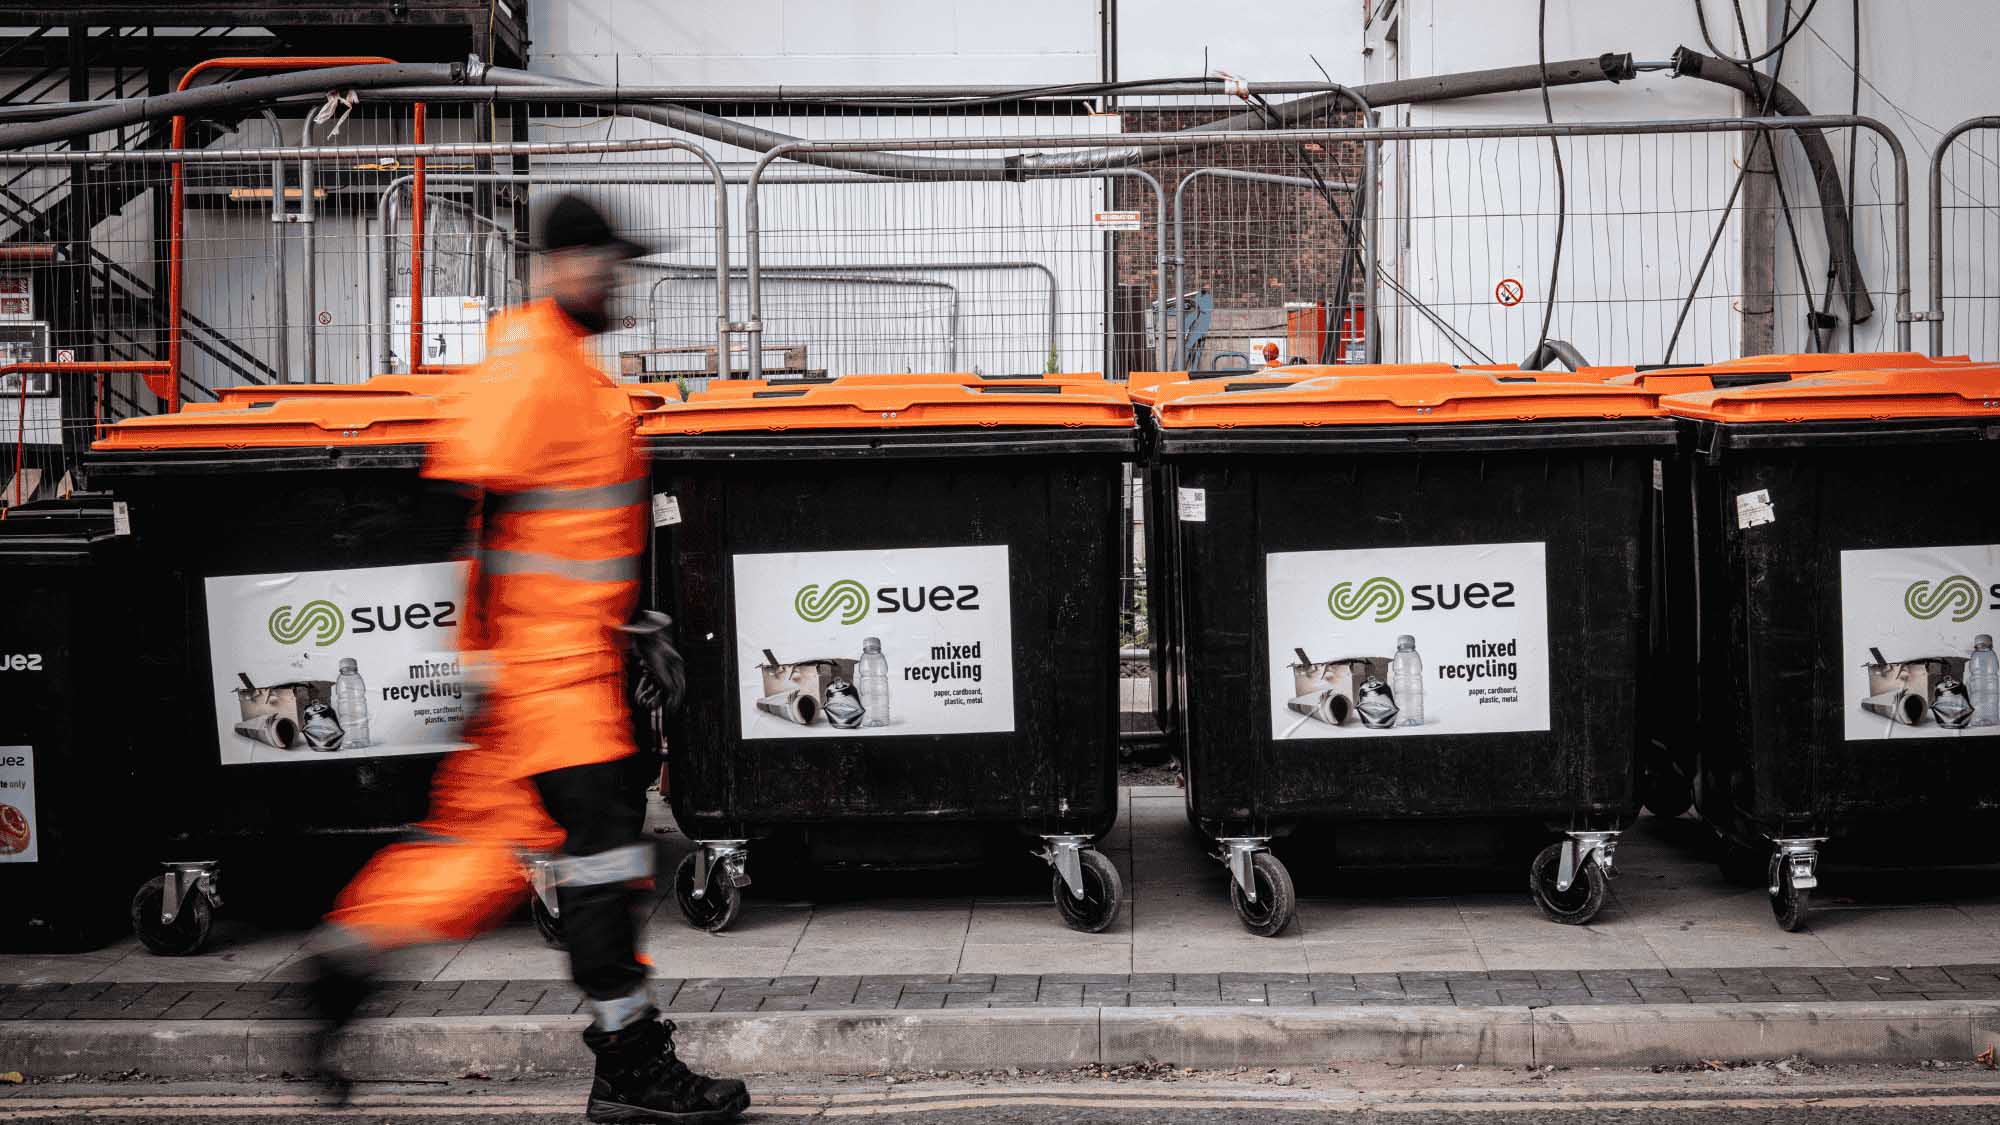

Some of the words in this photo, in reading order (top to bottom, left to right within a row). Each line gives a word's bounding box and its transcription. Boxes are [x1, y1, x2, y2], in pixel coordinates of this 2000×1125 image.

[877, 585, 980, 613] suez
[1411, 581, 1515, 610] suez
[351, 601, 457, 634] suez
[931, 641, 981, 660] mixed
[1466, 638, 1517, 658] mixed
[0, 653, 43, 671] uez
[409, 658, 461, 679] mixed
[1439, 660, 1518, 681] recycling
[904, 662, 982, 684] recycling
[383, 679, 462, 702] recycling
[933, 689, 951, 698] paper,
[952, 687, 983, 697] cardboard,
[1468, 687, 1487, 696] paper,
[1479, 696, 1500, 705] plastic,
[1501, 695, 1518, 703] metal
[944, 697, 965, 706] plastic,
[966, 696, 983, 704] metal
[0, 756, 25, 767] uez
